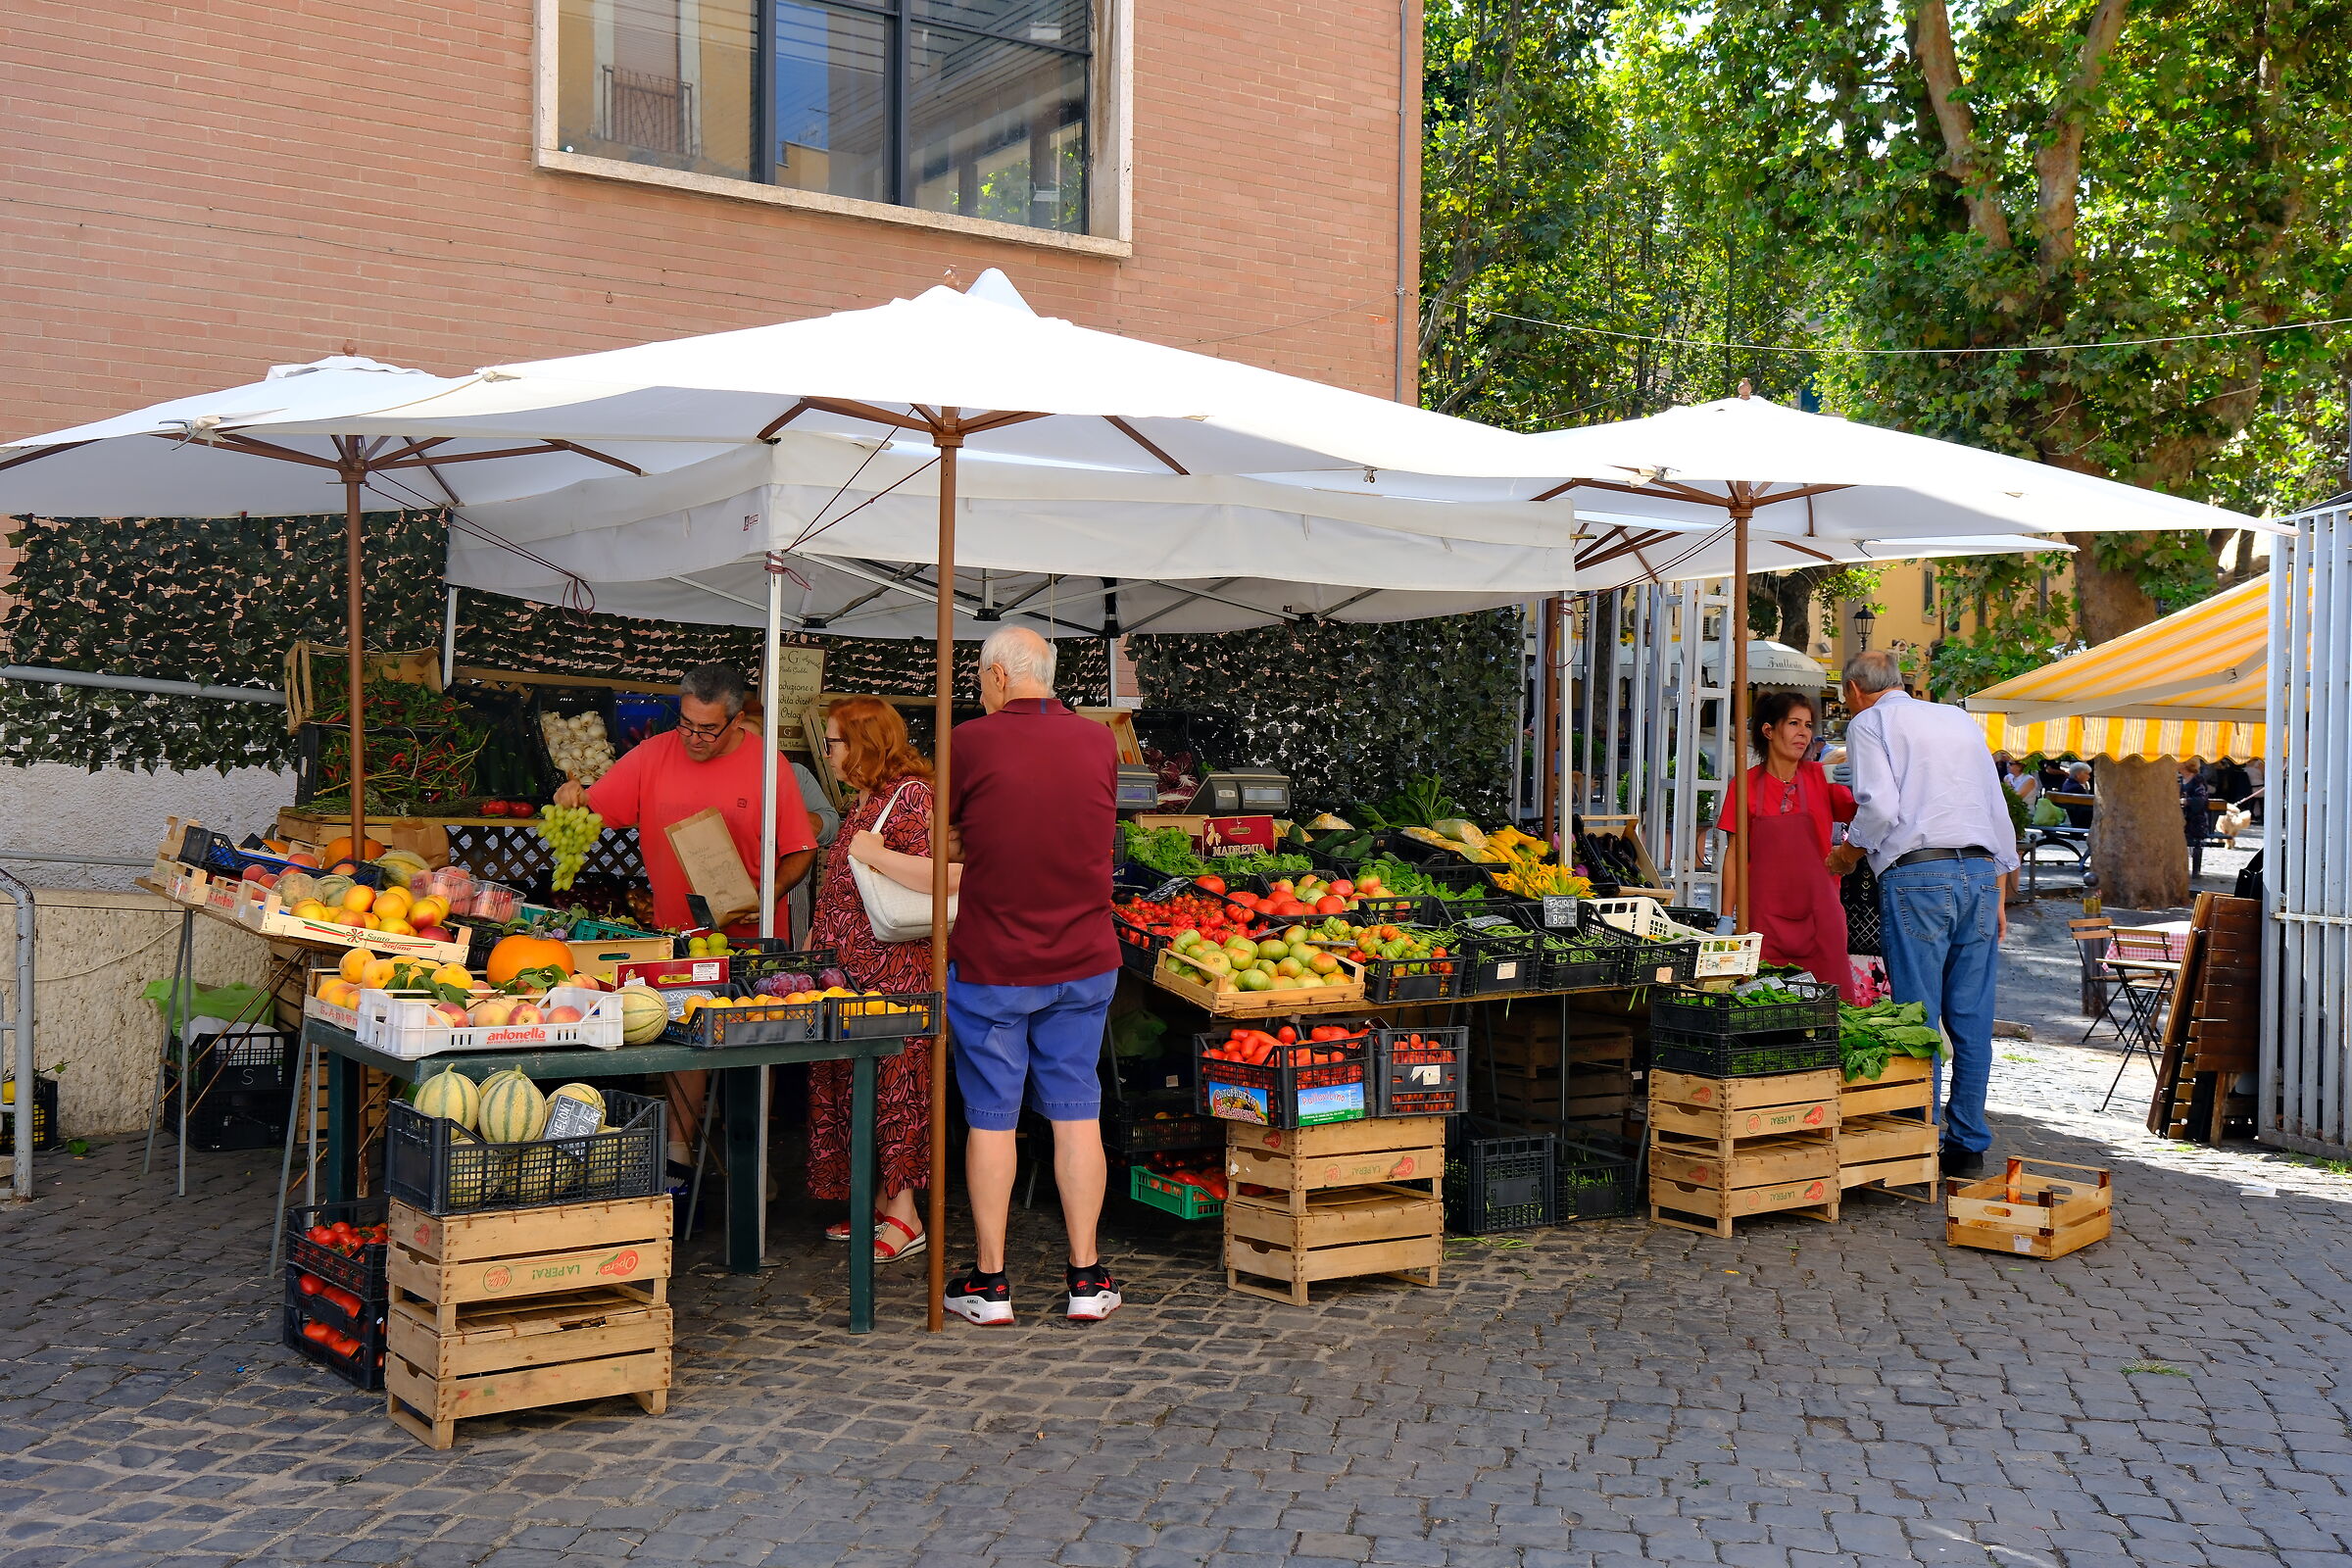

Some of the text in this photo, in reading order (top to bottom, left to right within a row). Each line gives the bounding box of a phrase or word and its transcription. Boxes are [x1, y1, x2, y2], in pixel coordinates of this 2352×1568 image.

[778, 680, 808, 695] oduzione
[780, 707, 804, 724] Ortag
[367, 933, 390, 943] Santo
[381, 942, 412, 952] Stefano
[487, 1027, 546, 1041] antonella
[241, 1068, 255, 1086] S
[552, 1102, 573, 1138] MELONI
[605, 1255, 637, 1271] Opera
[532, 1264, 581, 1280] LA PERA!
